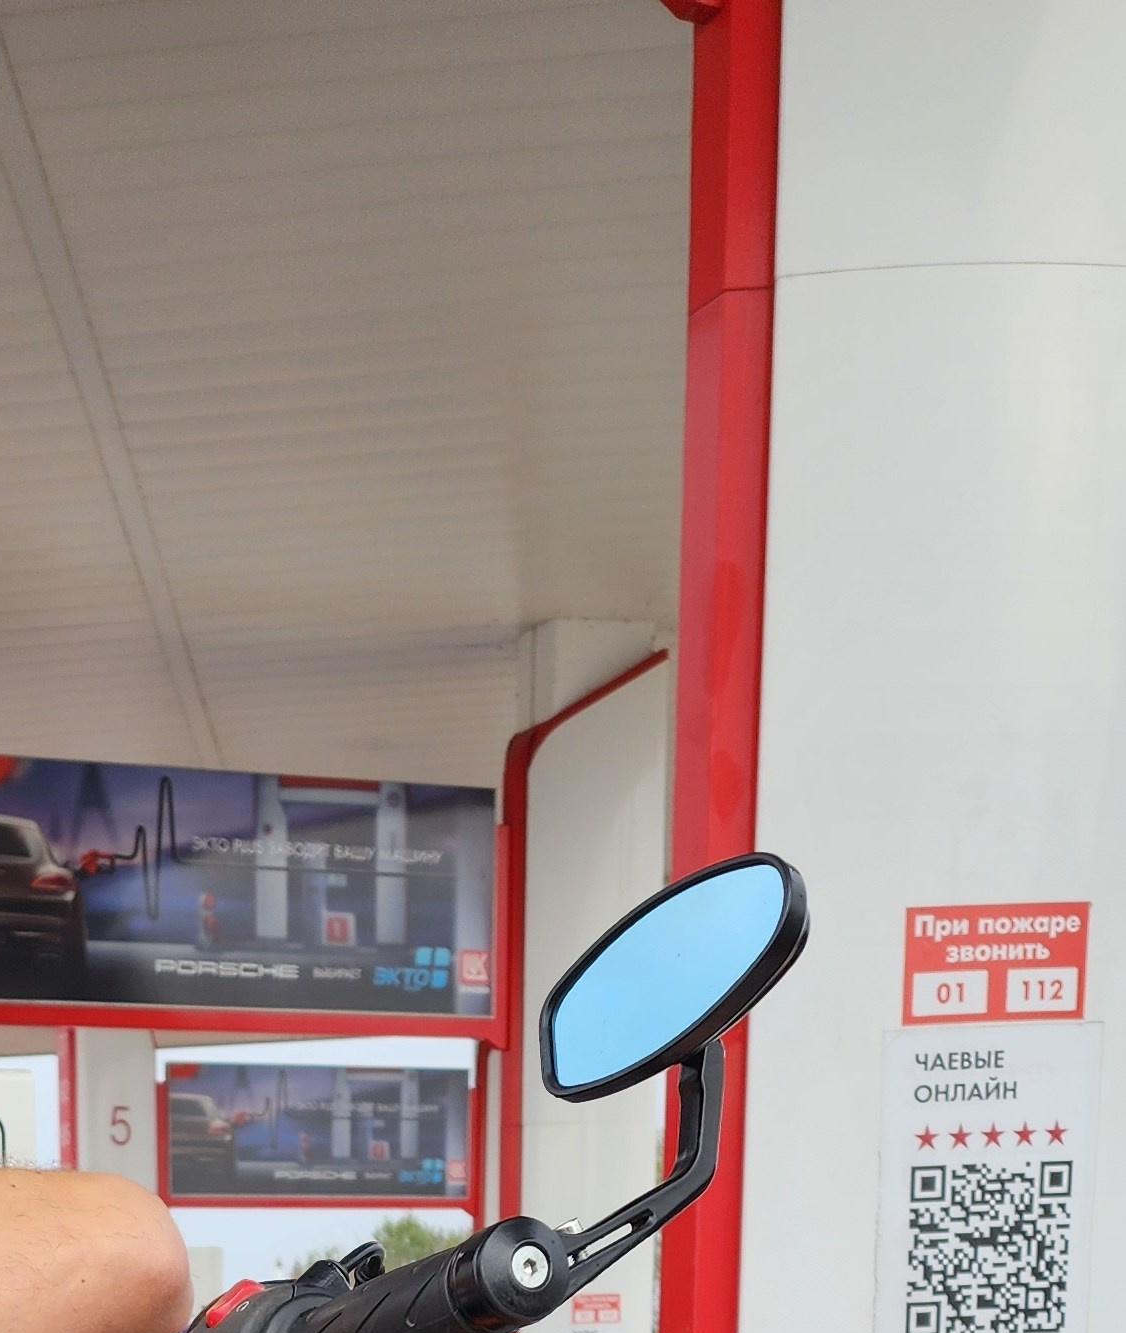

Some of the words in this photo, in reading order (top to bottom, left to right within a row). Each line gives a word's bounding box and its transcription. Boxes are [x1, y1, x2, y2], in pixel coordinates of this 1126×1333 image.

[914, 913, 969, 942] При
[978, 914, 1081, 938] пожаре
[945, 942, 1050, 963] звонить
[155, 958, 300, 979] PORSCHE
[374, 966, 431, 986] ЭКТО
[936, 983, 965, 1004] 01
[1023, 979, 1063, 1000] 112
[915, 1050, 1004, 1071] ЧАЕВЫЕ
[914, 1077, 1017, 1103] ОНЛАЙН
[110, 1105, 131, 1146] 5
